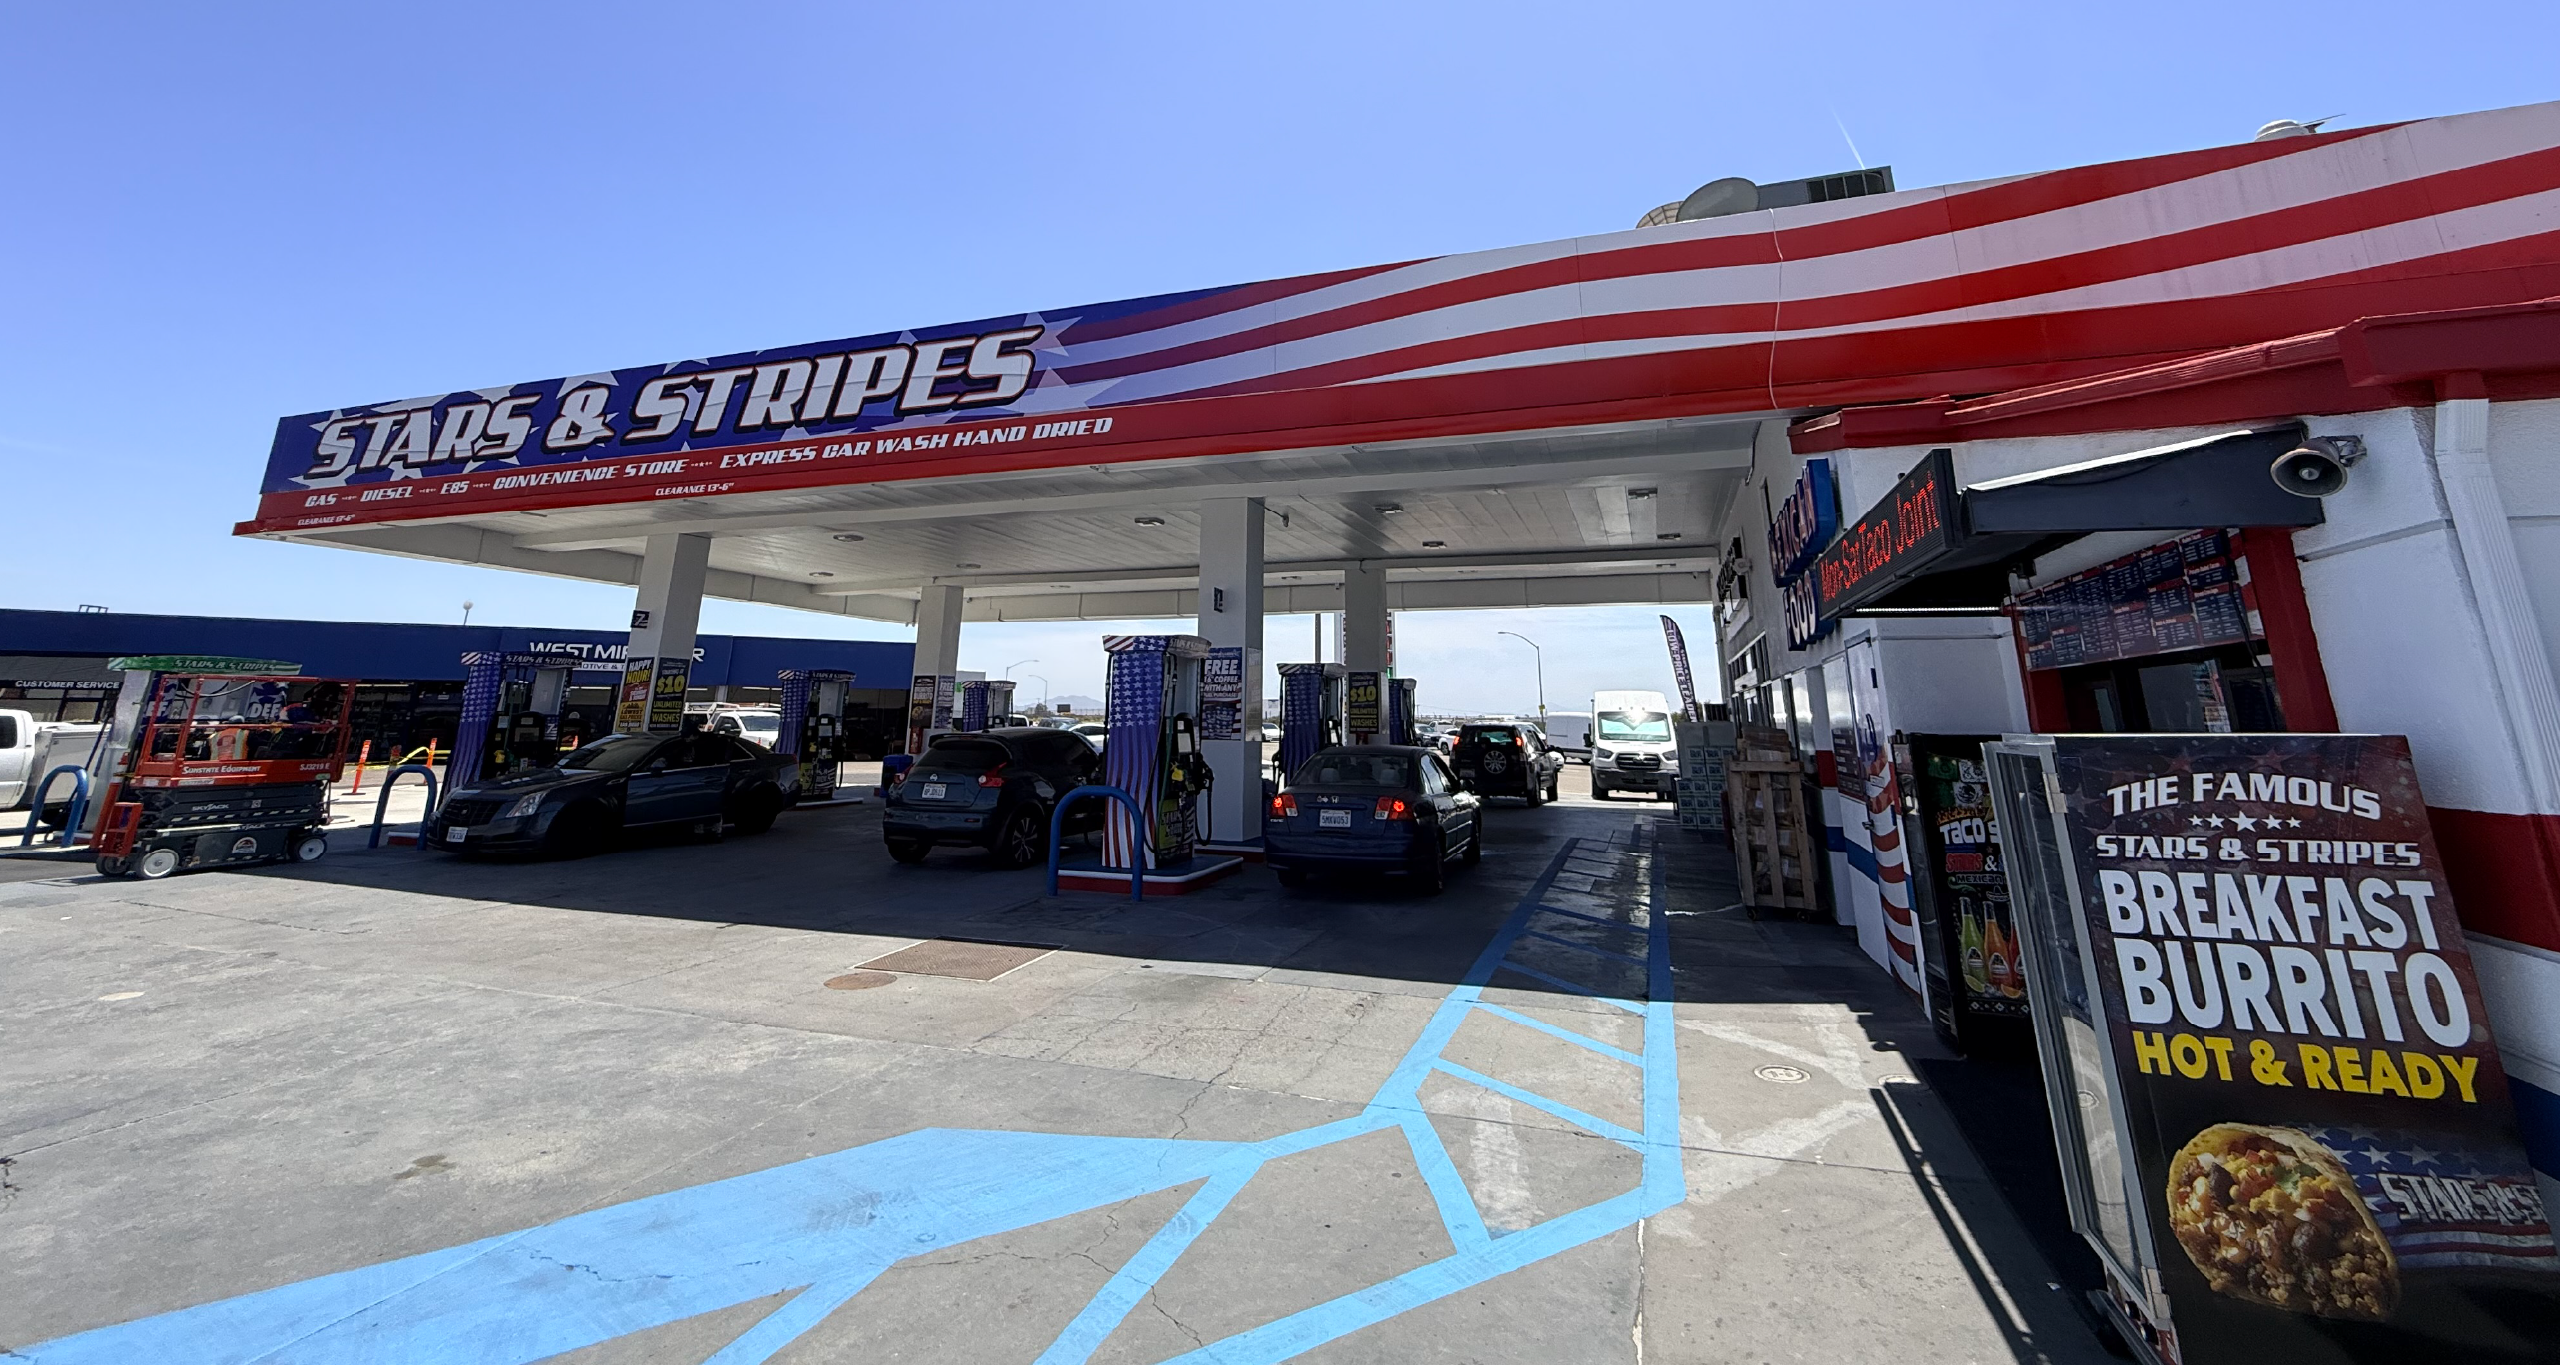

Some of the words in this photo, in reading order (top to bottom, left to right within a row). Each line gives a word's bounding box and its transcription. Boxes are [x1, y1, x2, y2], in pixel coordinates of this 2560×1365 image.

[305, 394, 542, 477] STARS
[545, 386, 616, 450] &
[622, 325, 1044, 441] STRIPES
[304, 493, 338, 508] GAS
[360, 486, 414, 502] DIESEL
[440, 481, 470, 494] E85
[492, 465, 620, 490] CONVENIENCE
[623, 459, 690, 478] STORE
[719, 445, 818, 469] EXPRESS
[822, 440, 871, 458] CAR
[875, 433, 951, 454] WASH
[952, 425, 1028, 447] HAND
[1031, 417, 1114, 441] DRIED
[655, 484, 706, 496] CLEARANCE
[1895, 470, 1941, 554] Joint
[1783, 569, 1817, 645] FOOD
[529, 641, 594, 659] WEST
[628, 659, 652, 672] HAPPY
[1204, 659, 1239, 675] FREE
[15, 680, 74, 688] CUSTOMER
[76, 681, 120, 689] SERVICE
[626, 669, 651, 684] HOUR!
[655, 674, 686, 694] $10
[1214, 675, 1239, 683] COFFEE
[1222, 684, 1237, 692] ANY
[1349, 685, 1377, 703] $10
[249, 702, 281, 718] DEF
[653, 700, 682, 708] UNLIMITED
[651, 712, 680, 723] WASHES
[1350, 719, 1377, 727] WASHES
[2106, 775, 2180, 817] THE
[2192, 771, 2382, 821] FAMOUS
[192, 803, 230, 811] SKYJACK
[2096, 834, 2209, 860] STARS
[2217, 837, 2252, 862] &
[2256, 838, 2422, 868] STRIPES
[1984, 854, 1998, 872] &
[2098, 869, 2440, 951] BREAKFAST
[2113, 937, 2472, 1048] BURRITO
[2131, 1029, 2235, 1082] HOT
[2249, 1038, 2294, 1087] &
[2297, 1042, 2479, 1103] READY
[2377, 1171, 2498, 1221] STARS
